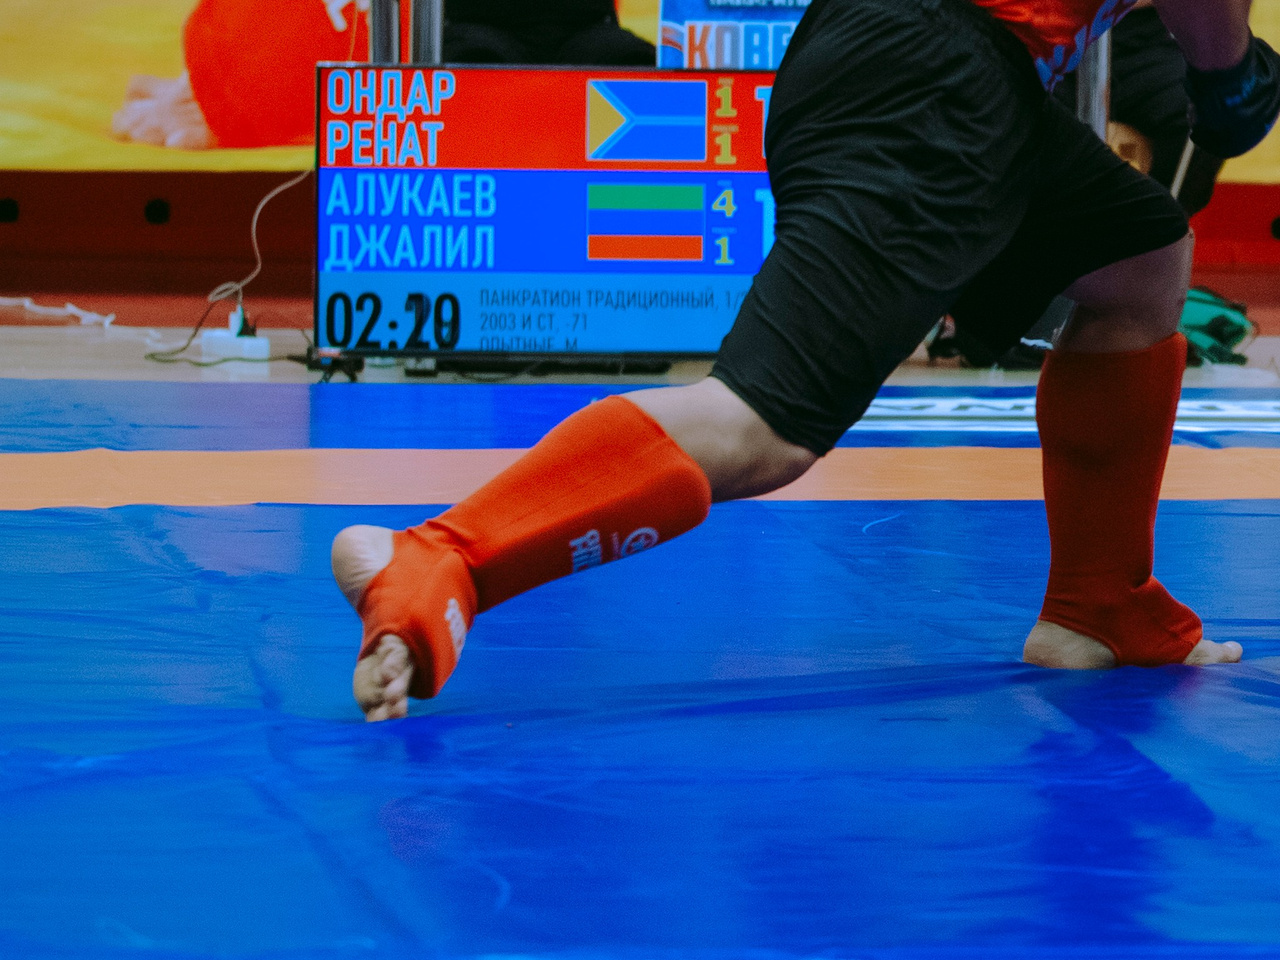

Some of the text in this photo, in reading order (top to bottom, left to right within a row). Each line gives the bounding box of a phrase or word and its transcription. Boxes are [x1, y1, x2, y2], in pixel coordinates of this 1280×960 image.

[327, 69, 456, 123] ОНДАР
[715, 86, 738, 117] 1
[326, 120, 445, 166] РЕНАТ
[714, 133, 737, 165] 1
[325, 172, 497, 218] АЛУКАЕВ
[711, 189, 738, 218] 4
[323, 223, 496, 273] ДЖАЛИЛ
[714, 236, 735, 265] 1
[480, 290, 581, 308] ПАНКРАТИОН
[480, 313, 517, 331] 2003
[521, 314, 533, 331] И
